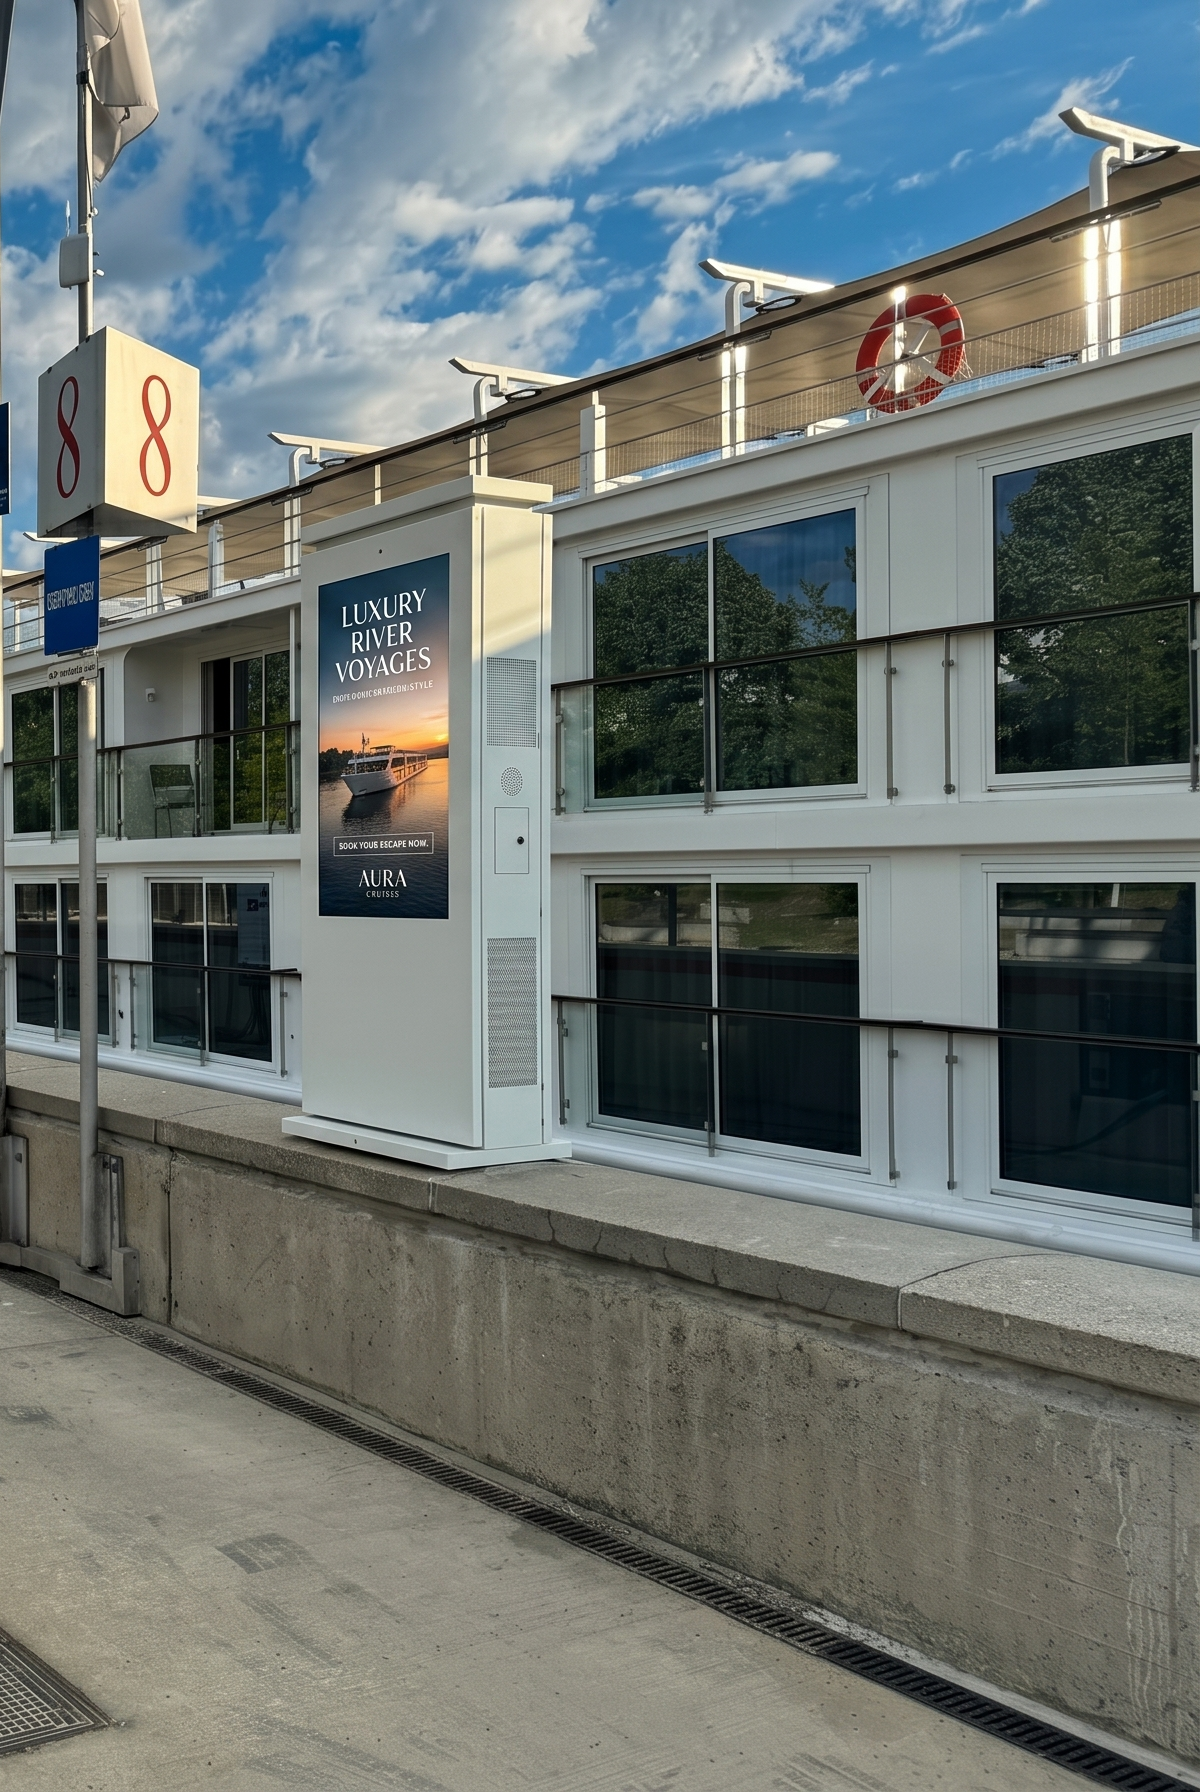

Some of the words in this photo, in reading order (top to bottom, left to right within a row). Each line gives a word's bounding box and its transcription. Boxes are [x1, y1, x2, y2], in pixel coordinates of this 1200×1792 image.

[56, 375, 80, 499] 8
[139, 374, 172, 497] 8
[342, 588, 427, 628] LUXURY
[351, 621, 413, 654] RIVER
[335, 646, 431, 683] VOYAGES
[380, 839, 407, 848] ESCAPE
[358, 869, 407, 888] AURA
